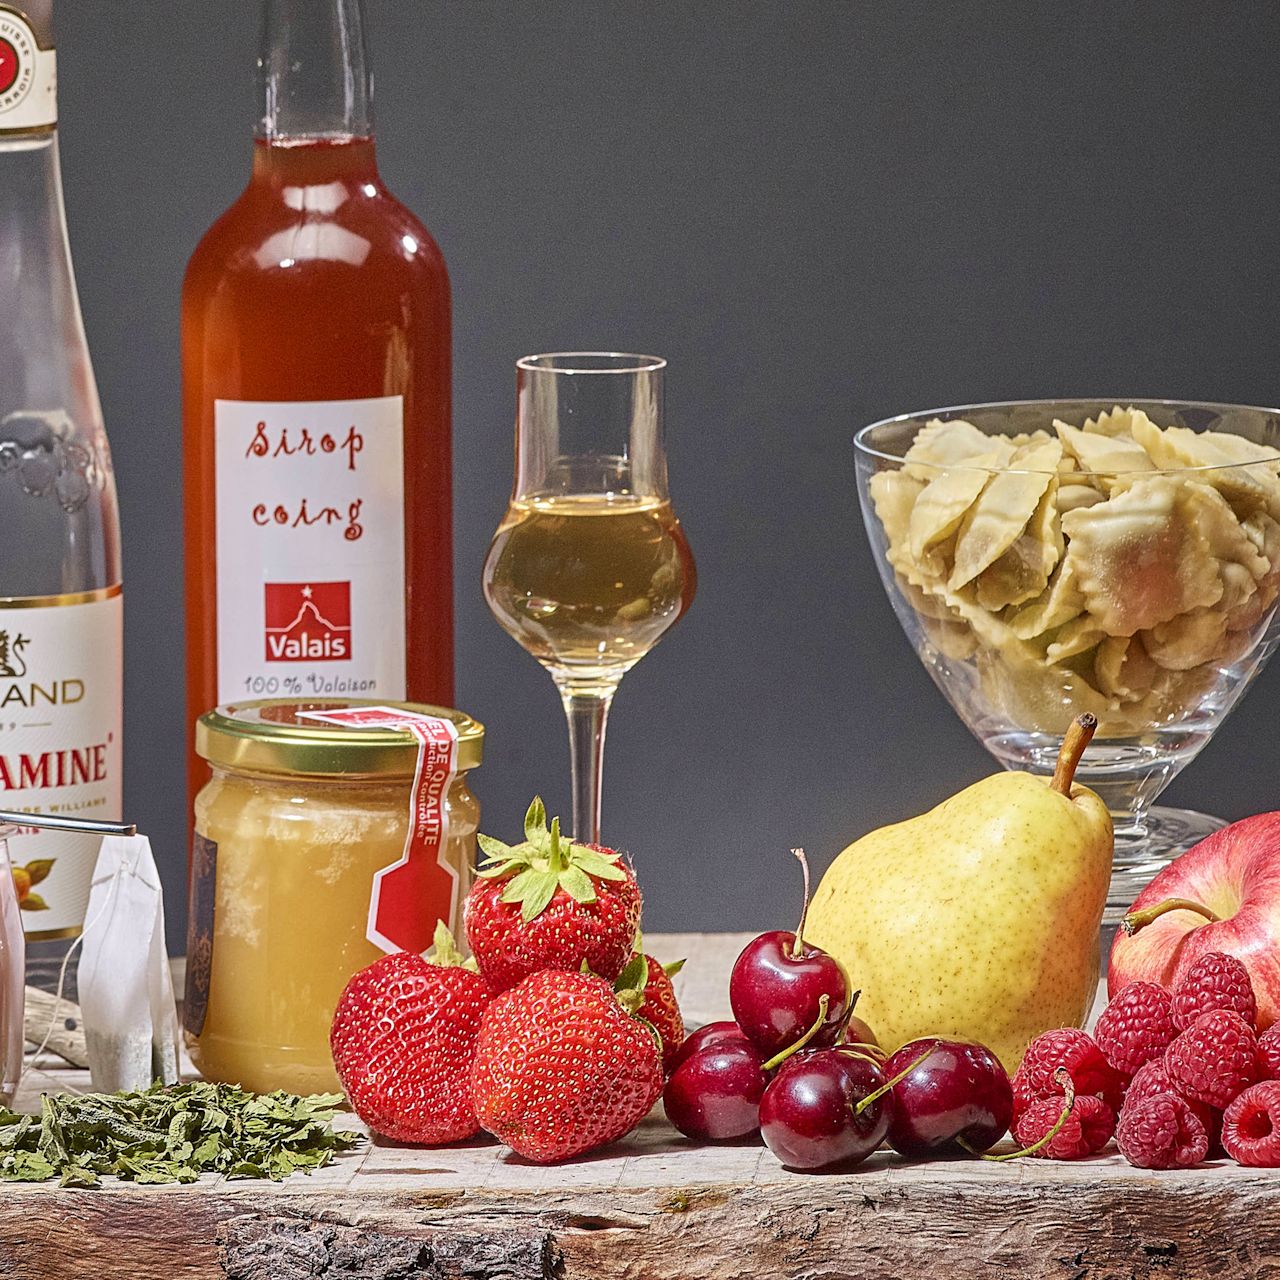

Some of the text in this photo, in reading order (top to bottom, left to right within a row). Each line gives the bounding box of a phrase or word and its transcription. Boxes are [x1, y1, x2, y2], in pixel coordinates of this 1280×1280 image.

[245, 421, 364, 470] Sirop
[252, 499, 363, 541] coing
[269, 631, 346, 658] Valais
[245, 676, 280, 694] 100
[437, 740, 450, 764] DE
[423, 770, 446, 846] QUALITE
